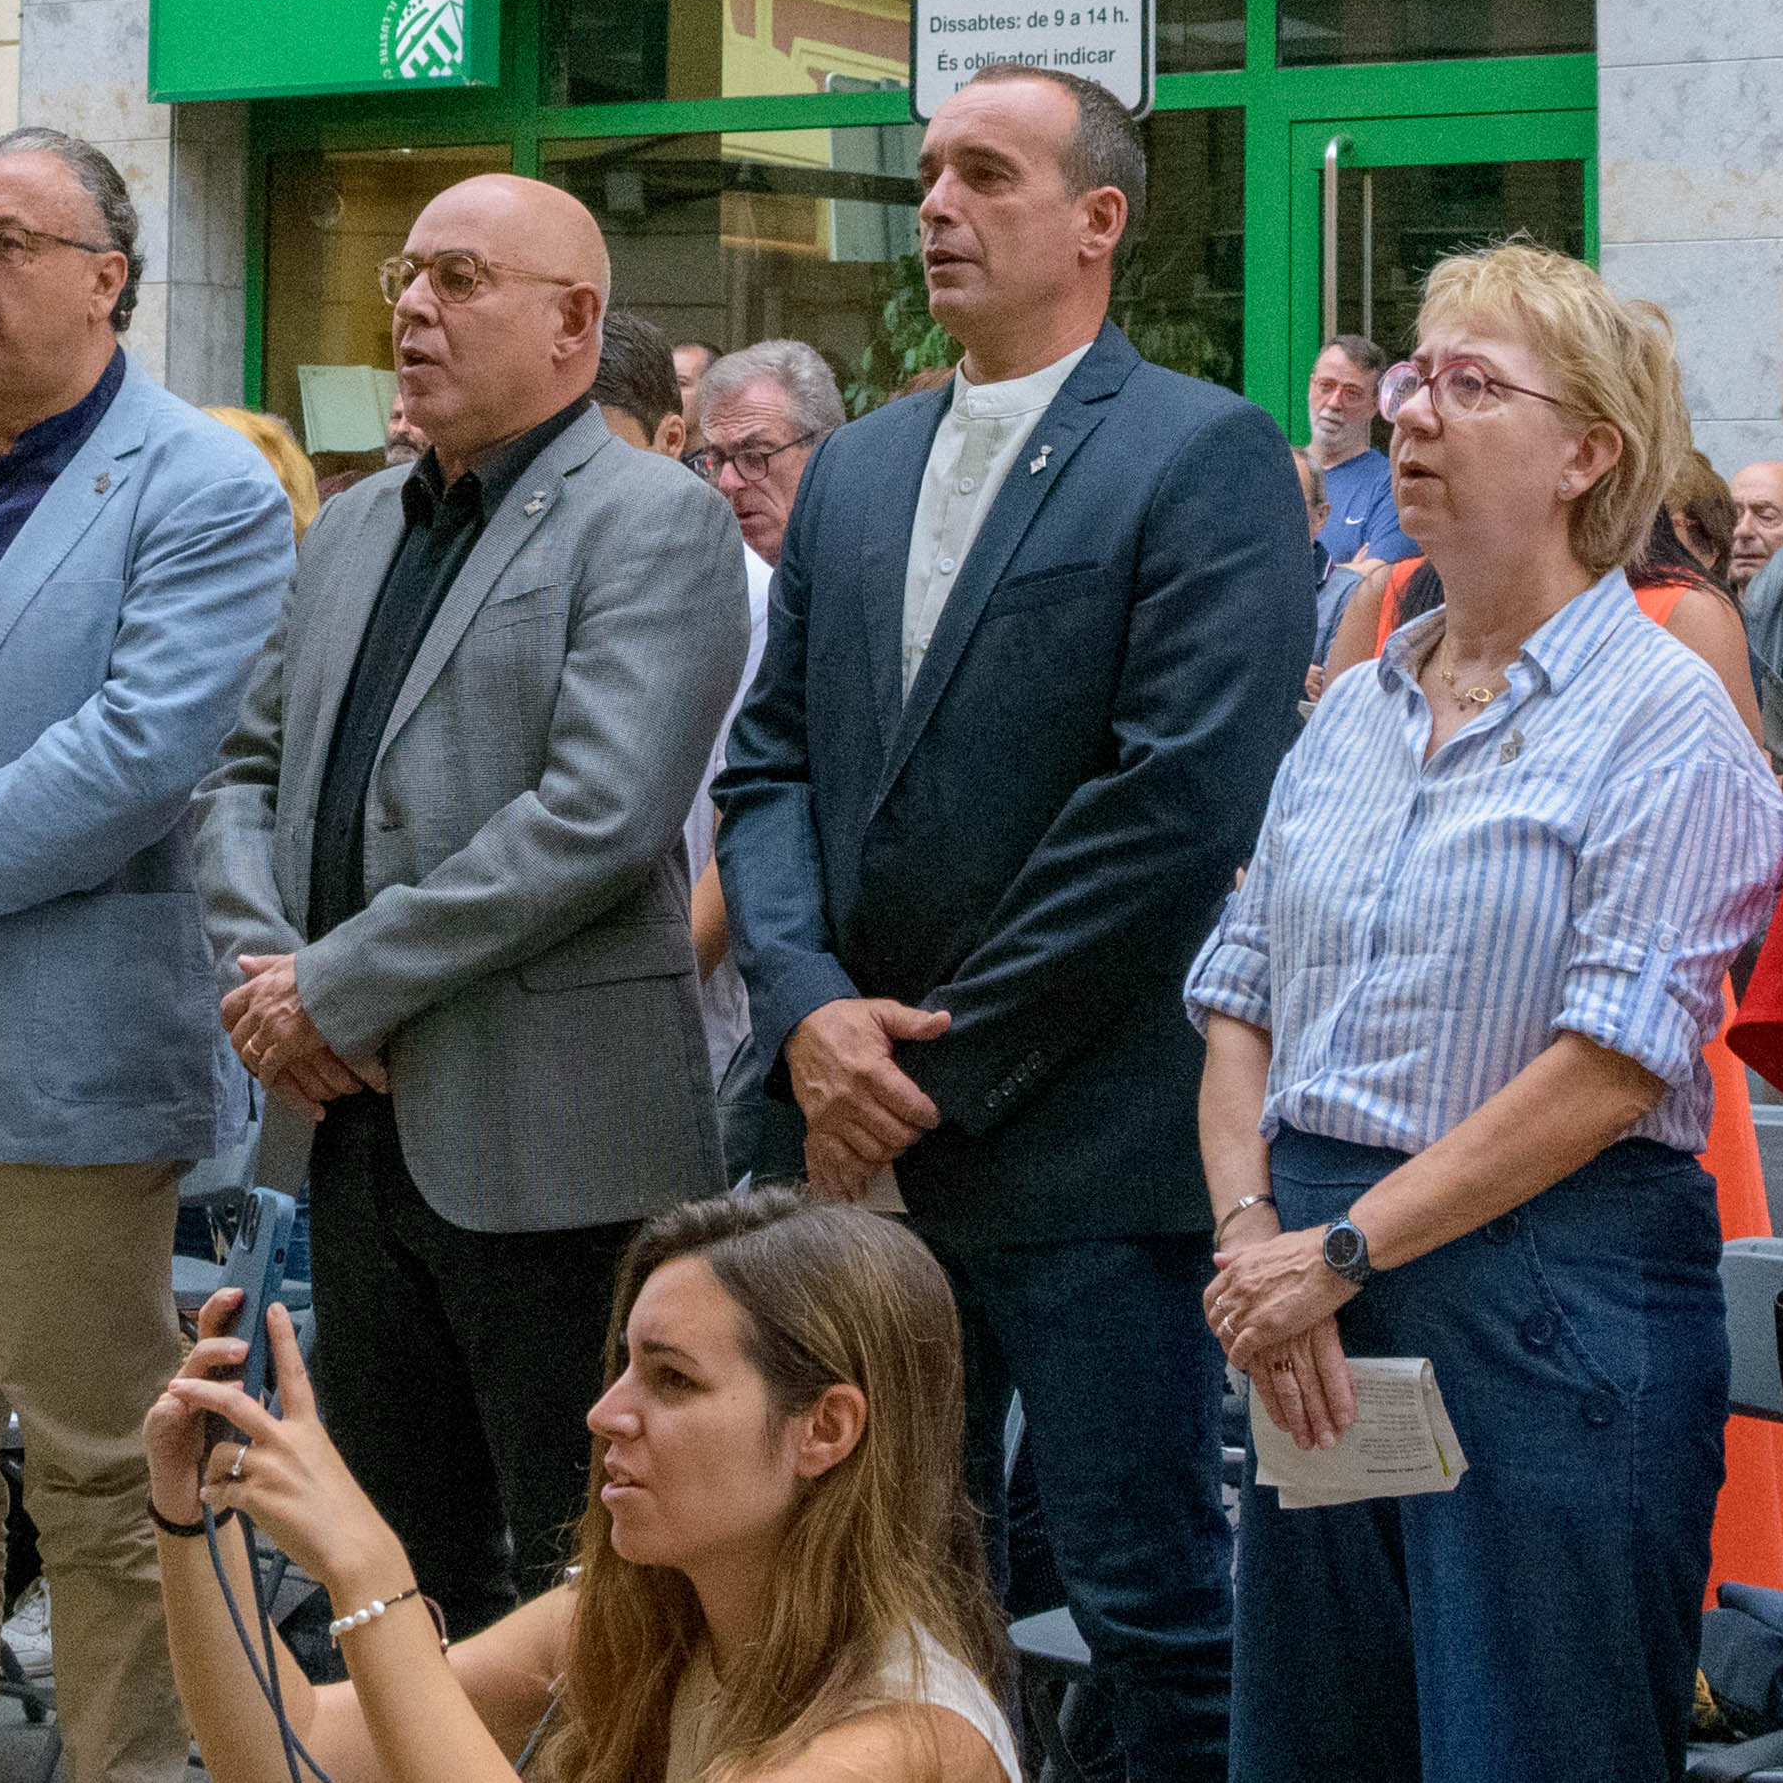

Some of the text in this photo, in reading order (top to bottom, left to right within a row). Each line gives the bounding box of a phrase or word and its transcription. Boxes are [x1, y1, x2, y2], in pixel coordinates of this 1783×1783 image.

[930, 6, 1129, 33] Dissabtes: de 9 a 14 h.
[937, 49, 958, 71] És
[1054, 46, 1116, 65] indicar
